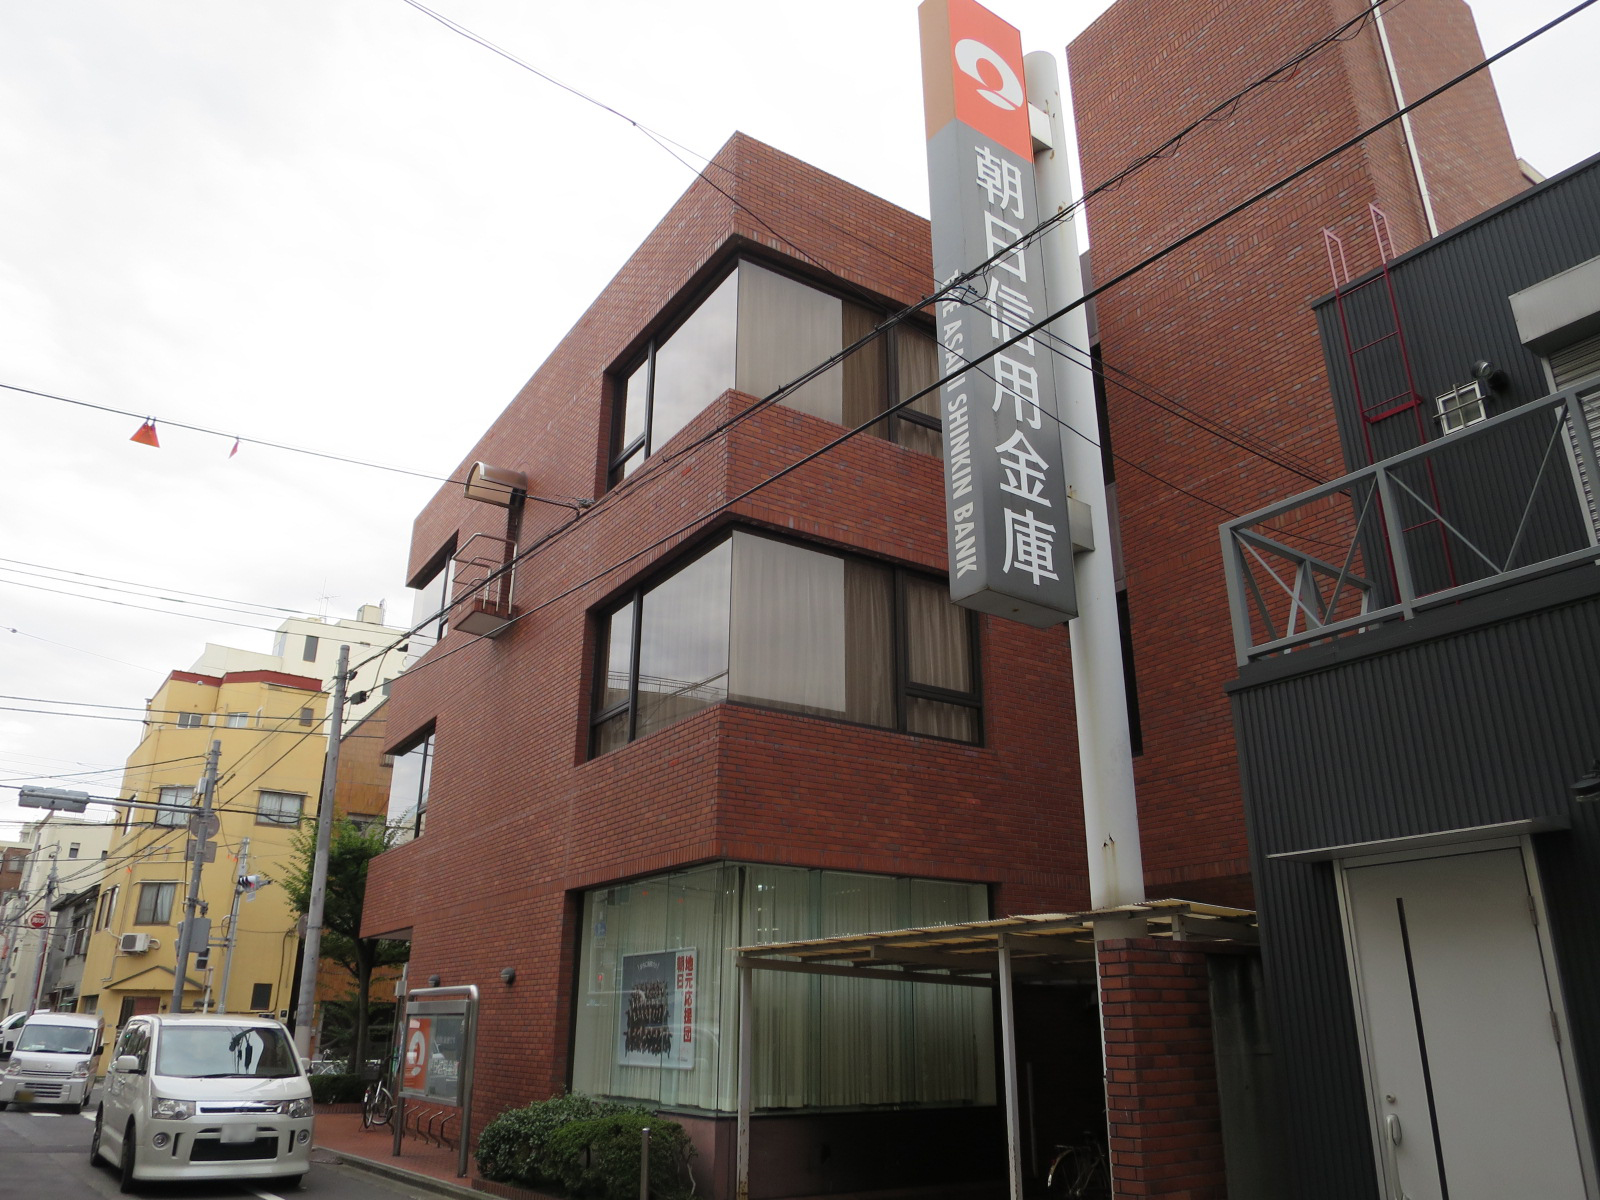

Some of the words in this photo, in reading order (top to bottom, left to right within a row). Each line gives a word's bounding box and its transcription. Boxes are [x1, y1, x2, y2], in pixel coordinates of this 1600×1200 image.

[944, 319, 966, 393] ASAHI
[975, 146, 1059, 586] 朝日信用金庫
[947, 394, 973, 499] SHINKIN
[953, 501, 977, 579] BANK
[676, 956, 685, 989] 朝日
[683, 955, 694, 1043] 地元応援団
